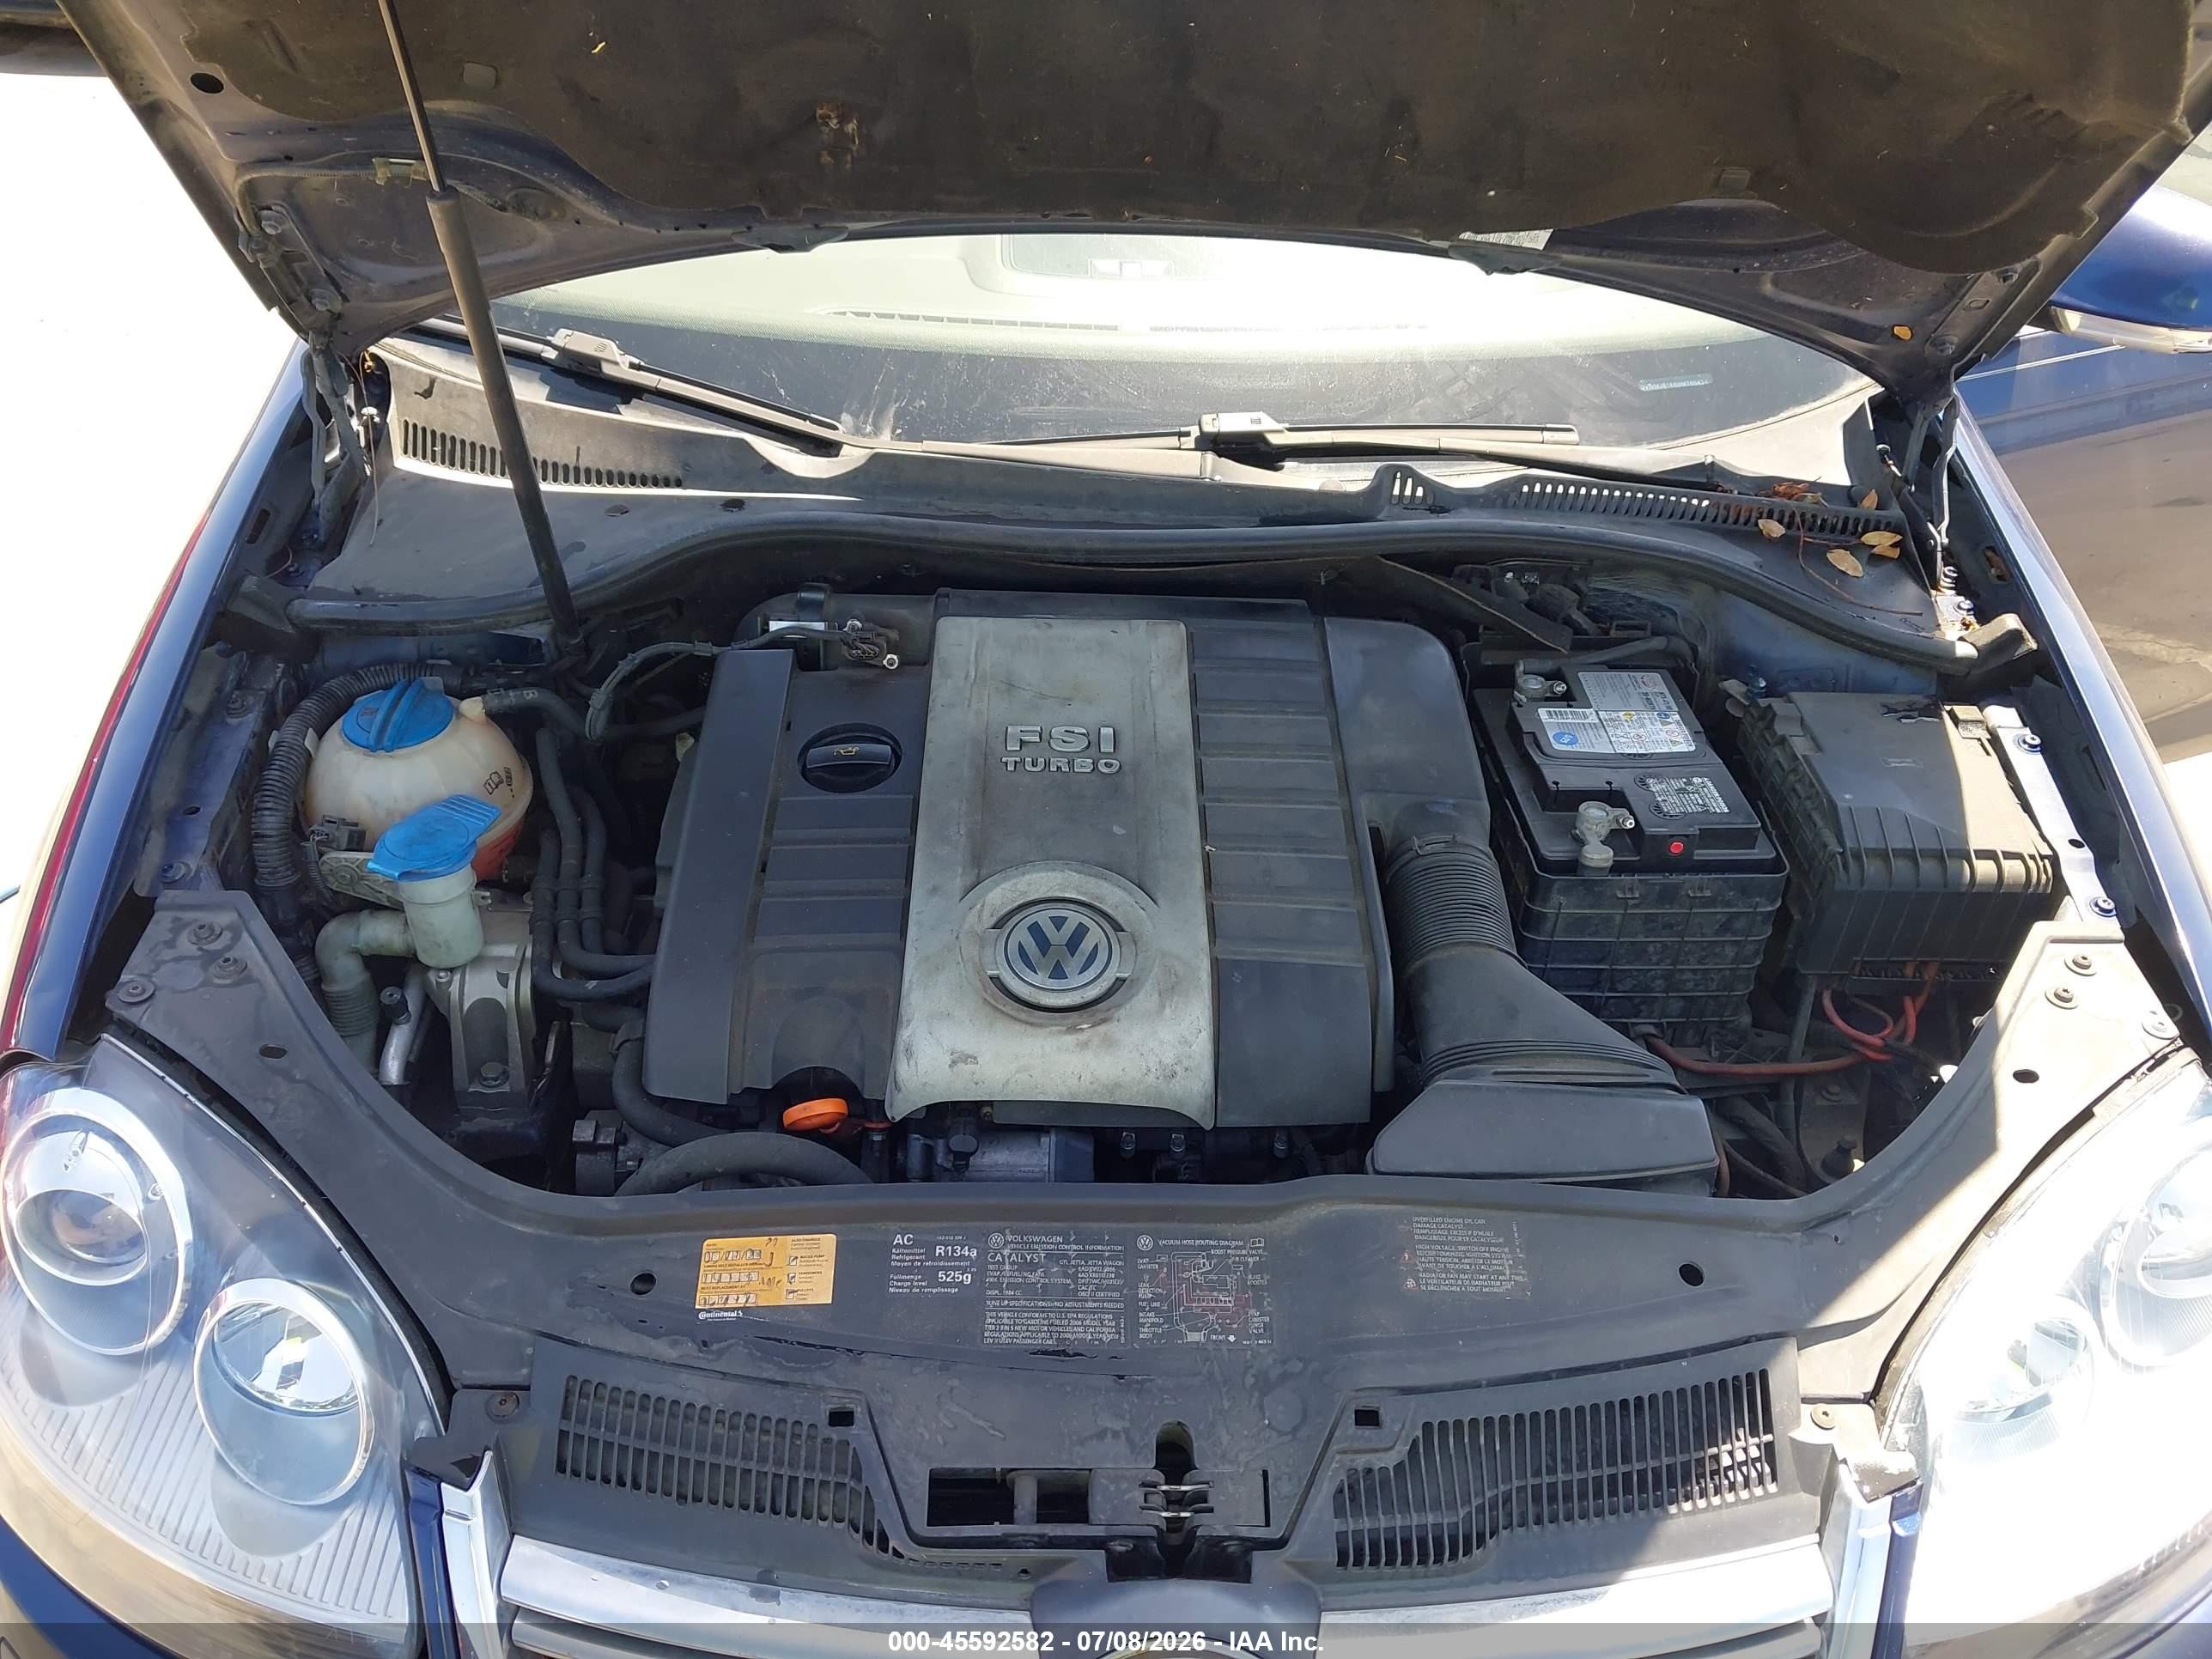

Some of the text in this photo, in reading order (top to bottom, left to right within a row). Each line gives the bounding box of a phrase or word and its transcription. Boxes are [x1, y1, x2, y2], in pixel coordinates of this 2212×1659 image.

[1006, 724, 1115, 753] FSI
[1000, 757, 1121, 774] TURBO
[1008, 910, 1109, 988] VW
[893, 1234, 914, 1245] AC
[1008, 1235, 1063, 1243] VOLKSWAGEN
[935, 1245, 977, 1257] R134a
[988, 1253, 1046, 1263] CATALYST
[938, 1271, 972, 1285] 525g
